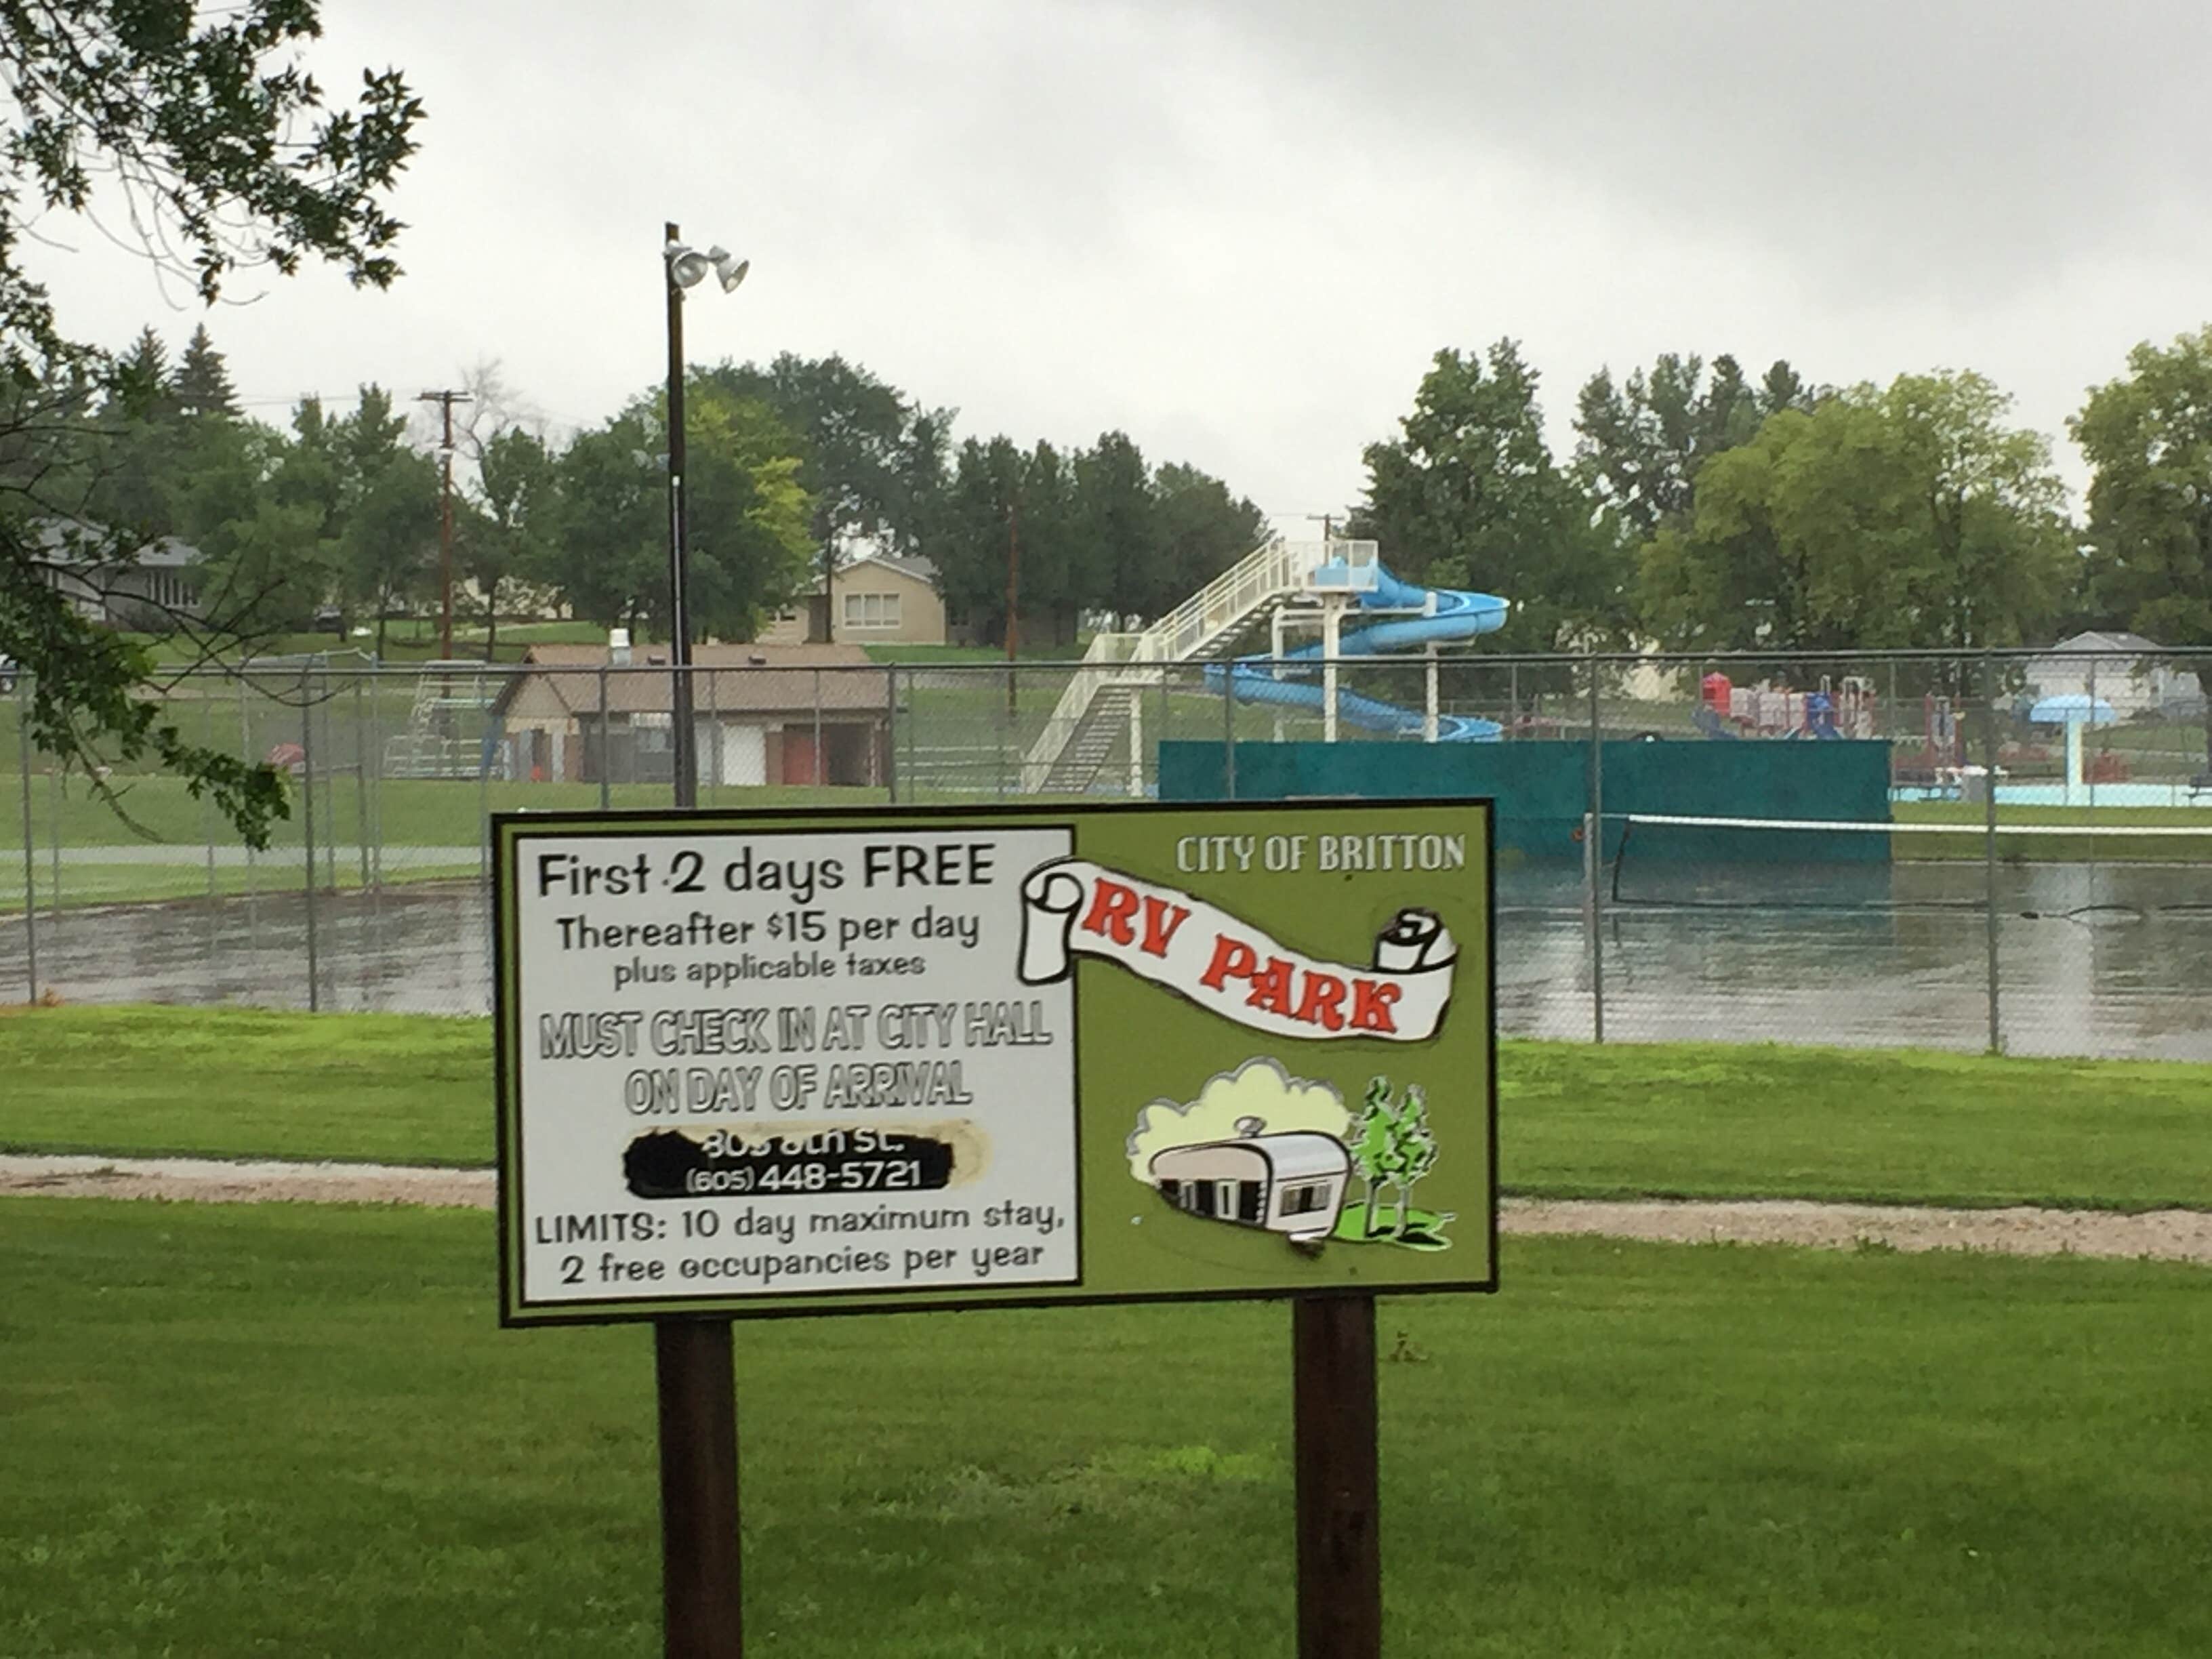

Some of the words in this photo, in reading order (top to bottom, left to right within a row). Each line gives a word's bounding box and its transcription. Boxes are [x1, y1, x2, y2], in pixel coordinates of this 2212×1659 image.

[538, 851, 650, 896] First
[670, 850, 706, 893] 2
[724, 846, 846, 903] days
[864, 844, 996, 887] FREE
[1176, 836, 1256, 873] CITY
[1265, 836, 1308, 870] OF
[1318, 834, 1465, 870] BRITTON
[554, 911, 755, 949] Thereafter
[766, 911, 827, 942] $15
[839, 917, 900, 953] per
[912, 905, 980, 948] day
[613, 956, 677, 991] plus
[687, 950, 836, 987] applicable
[847, 953, 926, 976] taxes
[1082, 878, 1191, 958] RV
[1200, 933, 1402, 1033] PARK
[540, 1010, 644, 1059] MUST
[651, 1008, 771, 1056] CHECK
[776, 1005, 815, 1053] IN
[821, 1006, 872, 1051] AT
[877, 1003, 958, 1050] CITY
[964, 1000, 1053, 1045] HALL
[624, 1066, 679, 1115] ON
[686, 1066, 764, 1114] DAY
[769, 1066, 817, 1109] OF
[823, 1059, 973, 1107] ARRIVAL
[686, 1166, 755, 1193] (605)
[758, 1160, 922, 1191] 448-5721
[535, 1212, 667, 1245] LIMITS:
[682, 1209, 720, 1240] 10
[734, 1205, 794, 1244] day
[810, 1204, 970, 1232] maximum
[983, 1200, 1065, 1235] stay,
[560, 1254, 586, 1285] 2
[598, 1252, 665, 1282] free
[680, 1246, 890, 1285] occupancies
[904, 1248, 957, 1279] per
[971, 1246, 1045, 1278] year
